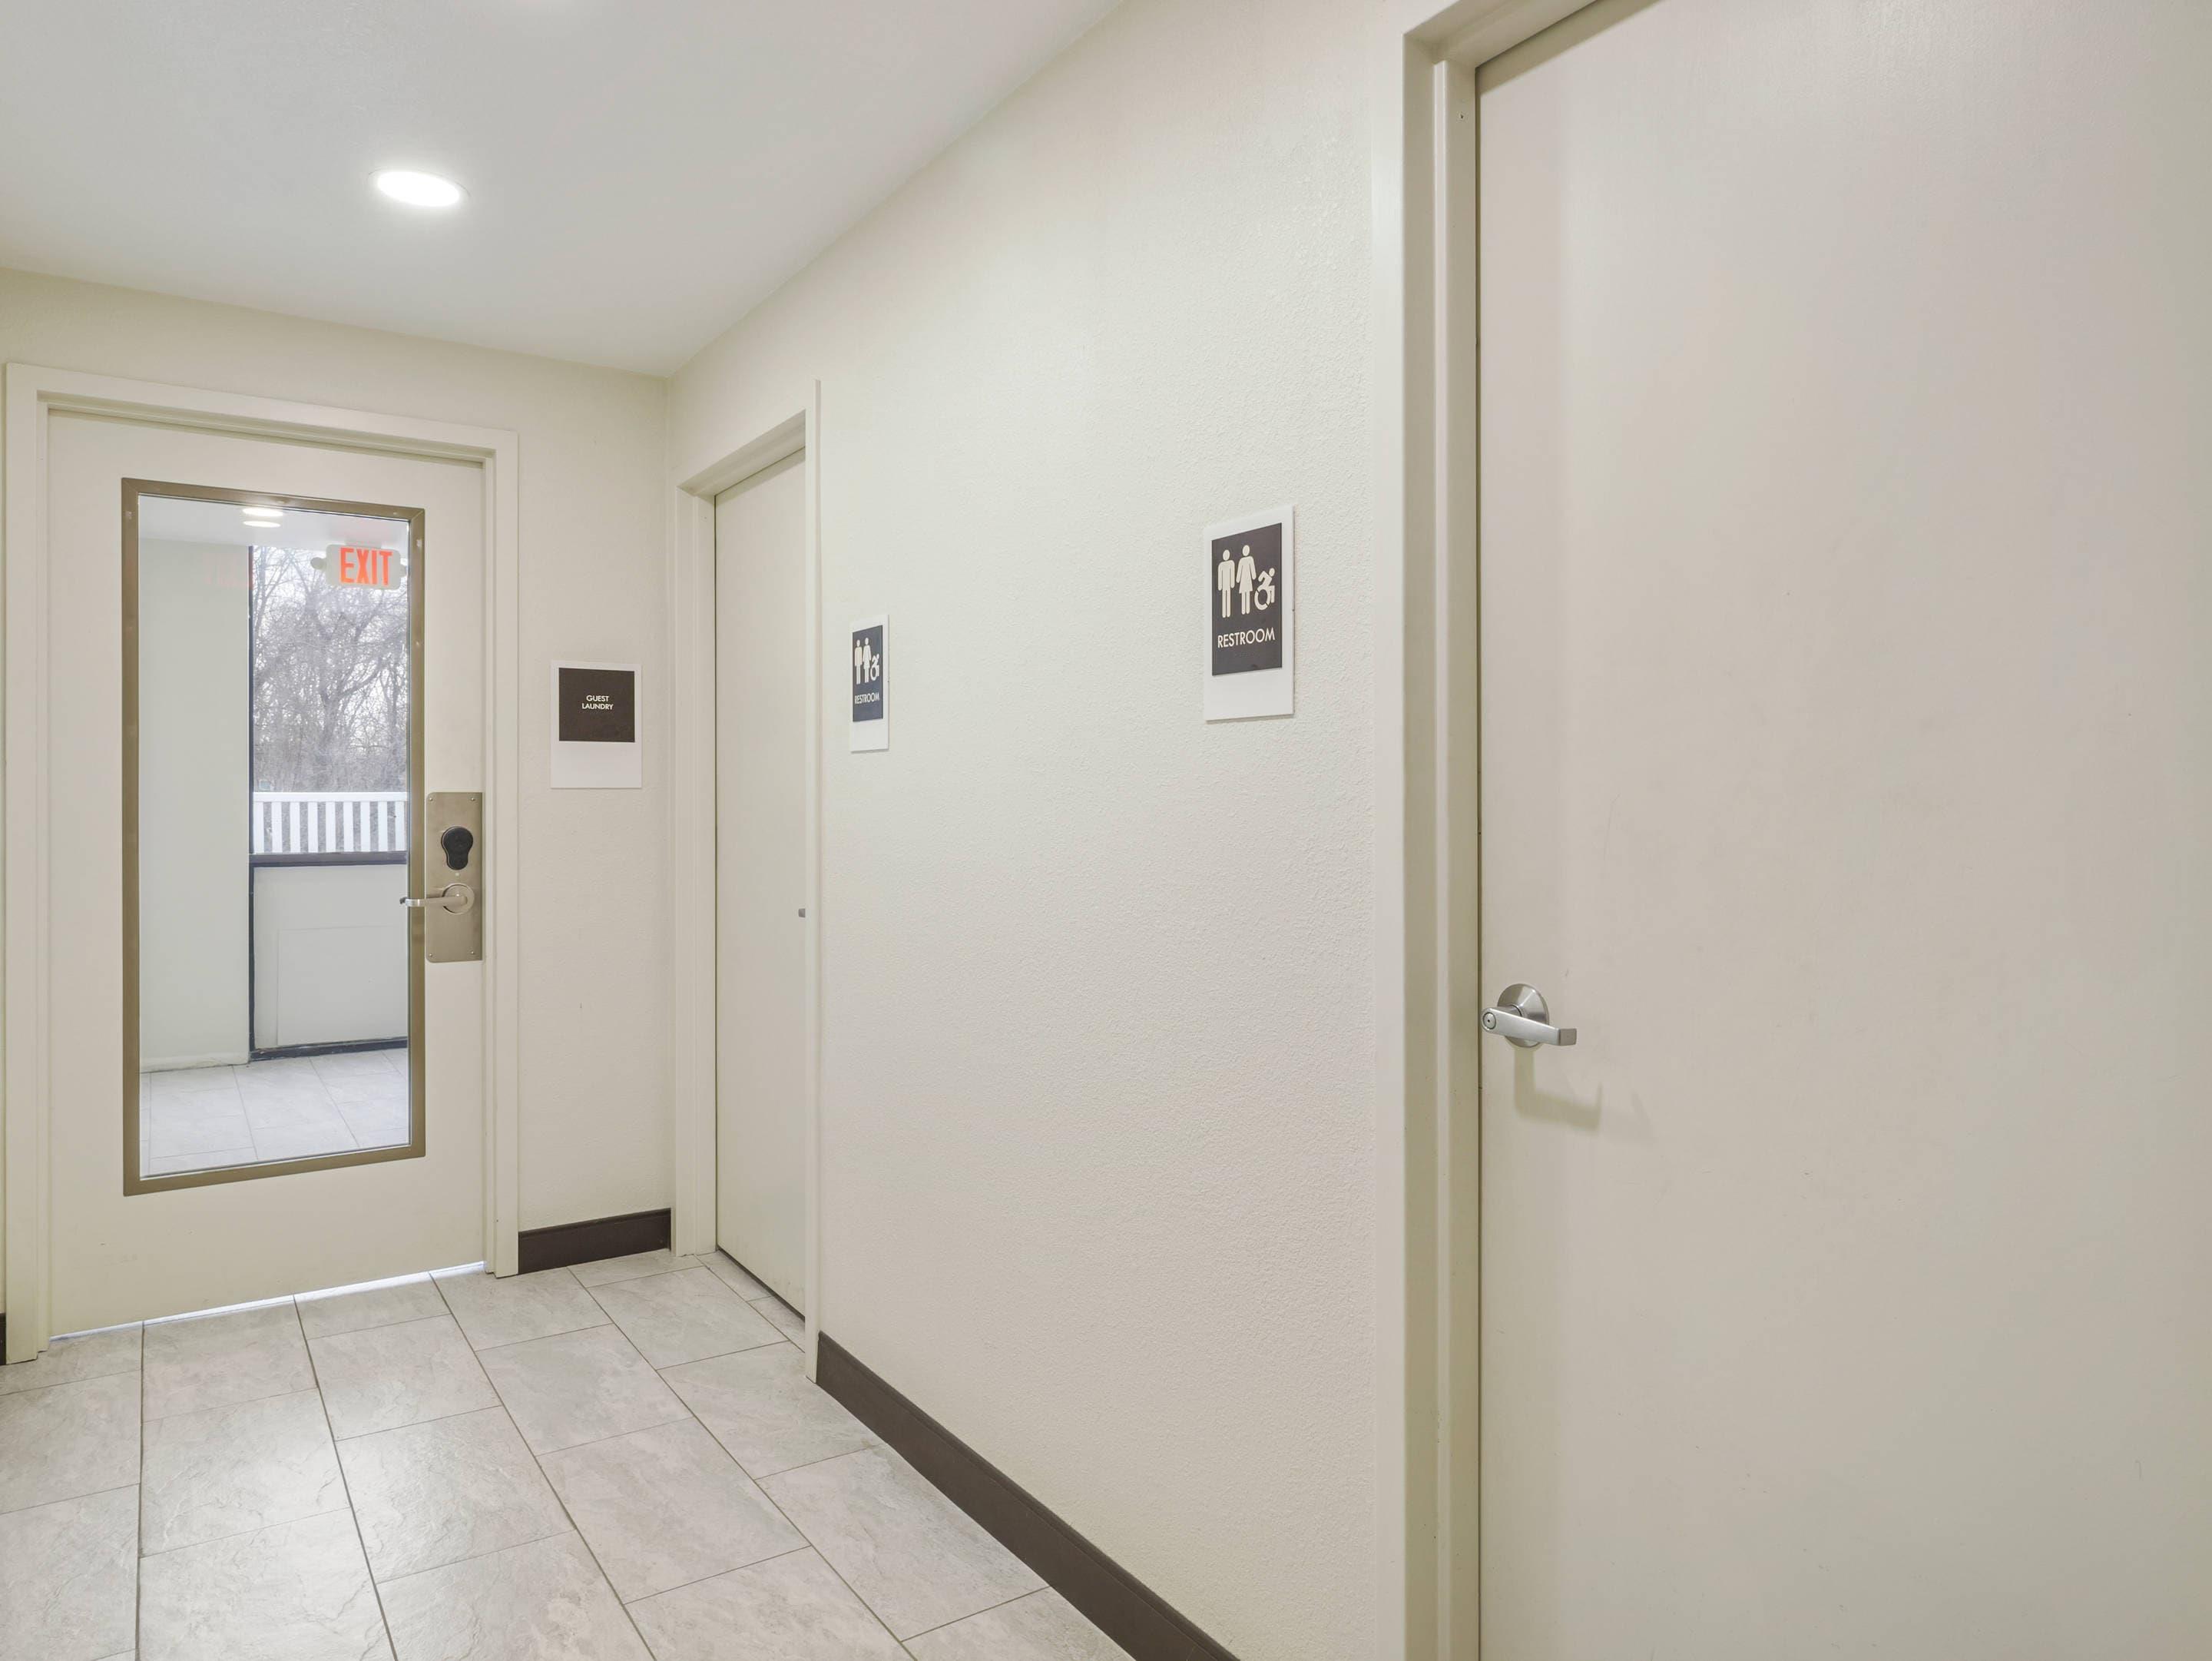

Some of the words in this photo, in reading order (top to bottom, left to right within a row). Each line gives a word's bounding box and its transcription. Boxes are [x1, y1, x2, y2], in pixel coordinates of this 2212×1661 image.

[340, 547, 392, 585] EXIT
[1217, 627, 1276, 648] RESTROOM
[854, 692, 880, 705] RESTROOM
